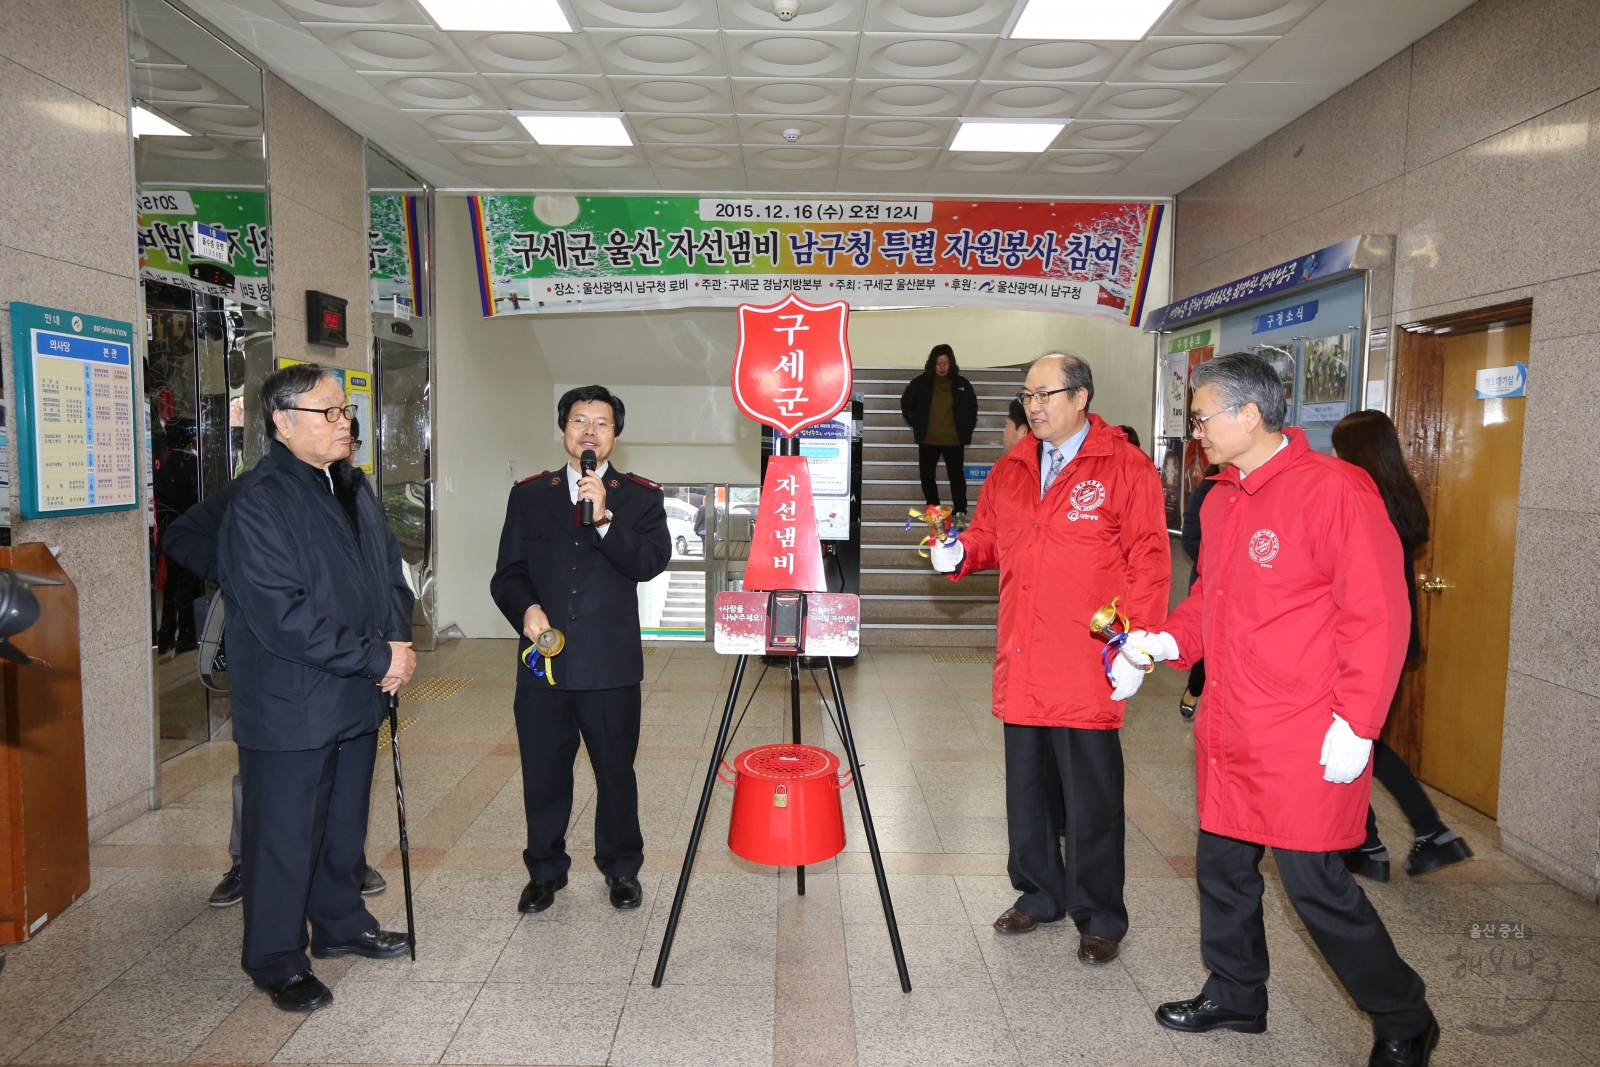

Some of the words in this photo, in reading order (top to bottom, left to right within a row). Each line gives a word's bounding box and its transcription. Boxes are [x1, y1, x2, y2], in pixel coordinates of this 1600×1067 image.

[849, 204, 880, 219] 오전
[885, 206, 918, 219] 12시
[513, 229, 597, 269] 구세군
[604, 229, 663, 266] 울산
[669, 229, 780, 266] 자선냄비
[789, 230, 872, 267] 남구청
[880, 230, 937, 267] 특별
[944, 229, 1058, 270] 자원봉사
[1064, 234, 1122, 275] 참여
[1259, 261, 1298, 292] 행복남구
[582, 280, 634, 295] 울산광역시
[635, 279, 667, 294] 남구청
[669, 278, 689, 292] 로비
[729, 278, 760, 291] 구세군
[763, 278, 823, 292] 경남지방본부
[863, 278, 894, 291] 구세군
[896, 278, 936, 291] 울산본부
[997, 280, 1048, 297] 울산광역시
[1051, 286, 1082, 300] 남구청
[44, 312, 61, 326] 안내
[93, 324, 128, 337] INFORMATION
[49, 338, 71, 354] 의사당
[771, 313, 810, 418] 구세군
[772, 474, 801, 575] 자선냄비
[722, 604, 745, 614] 사랑을
[738, 613, 763, 622] 주세요!
